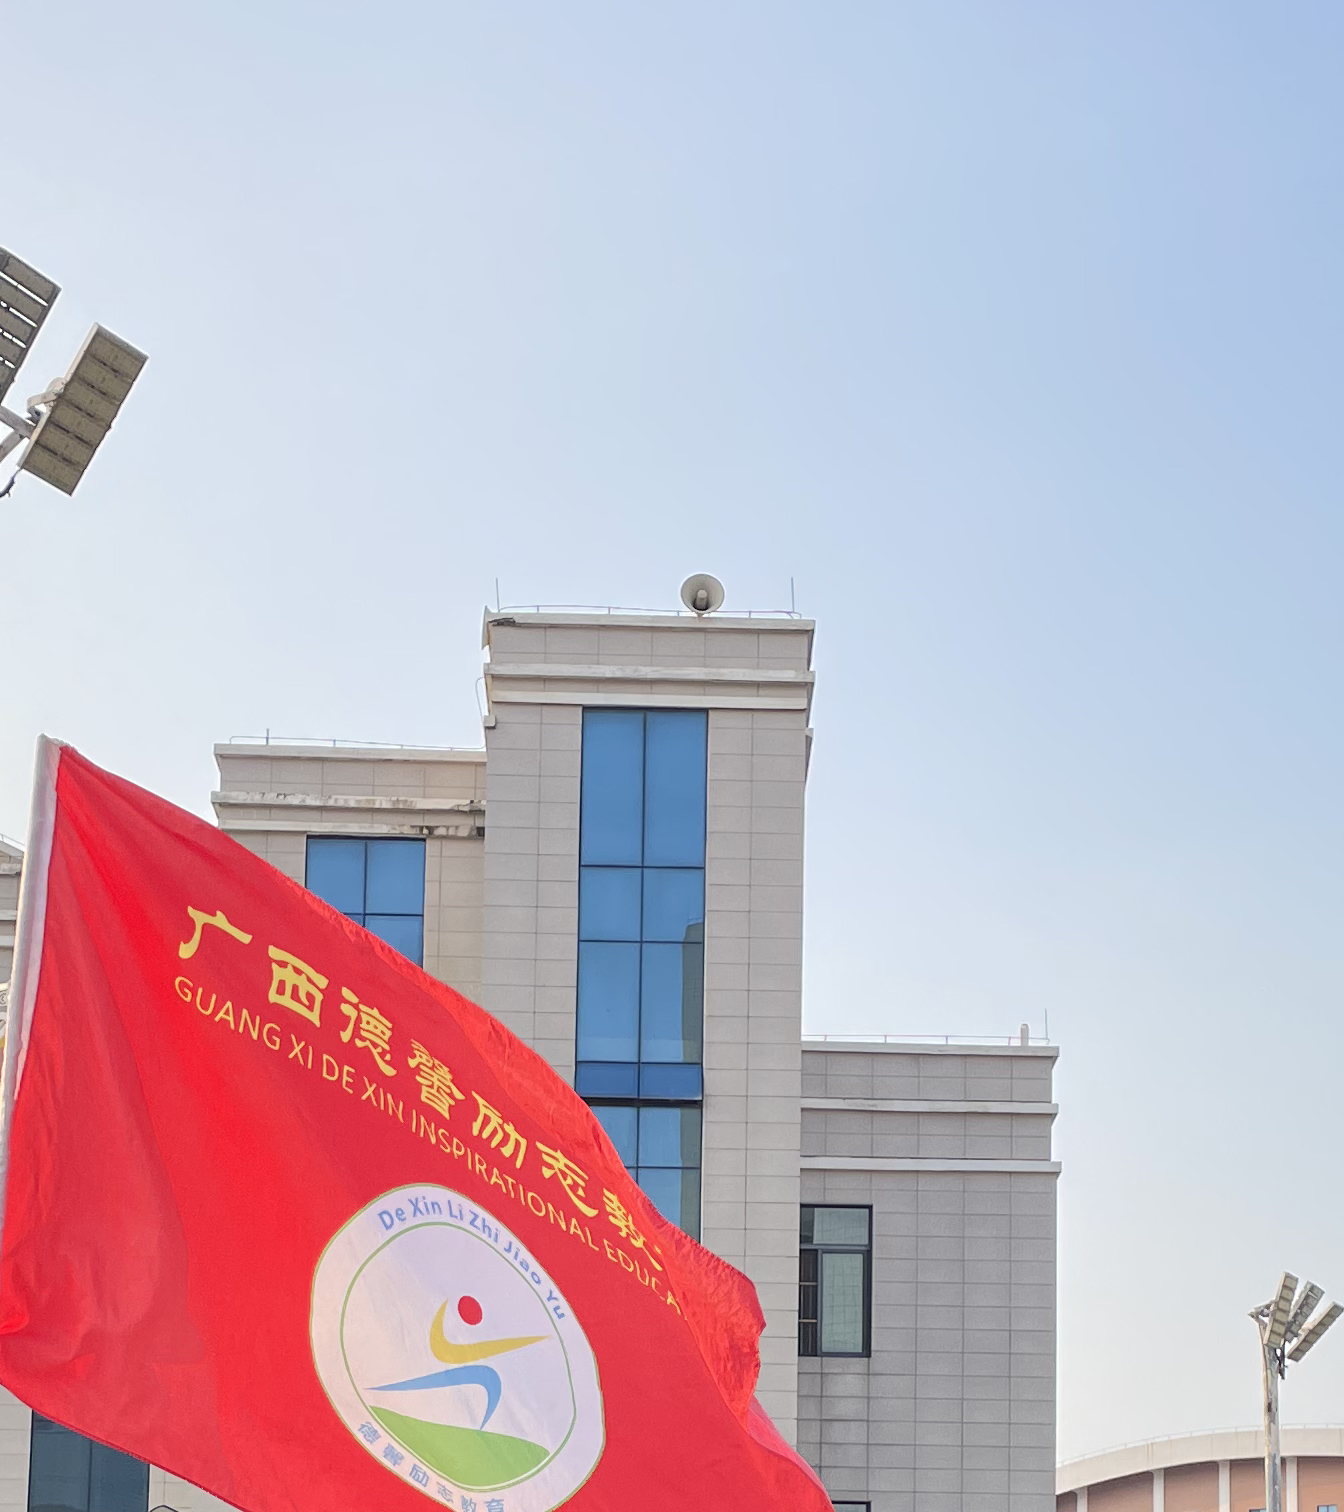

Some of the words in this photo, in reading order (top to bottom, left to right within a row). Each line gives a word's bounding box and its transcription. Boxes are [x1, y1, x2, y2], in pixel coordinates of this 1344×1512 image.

[174, 975, 281, 1051] GUANG
[288, 1033, 314, 1070] XI
[322, 1053, 356, 1095] DE
[361, 1075, 405, 1124] XIN
[411, 1109, 600, 1252] INSPIRATIONAL
[378, 1207, 407, 1232] De
[408, 1195, 444, 1219] Xin
[447, 1198, 465, 1222] Li
[468, 1209, 501, 1245] Zhi
[503, 1239, 543, 1286] Jiao
[545, 1288, 566, 1321] Yu
